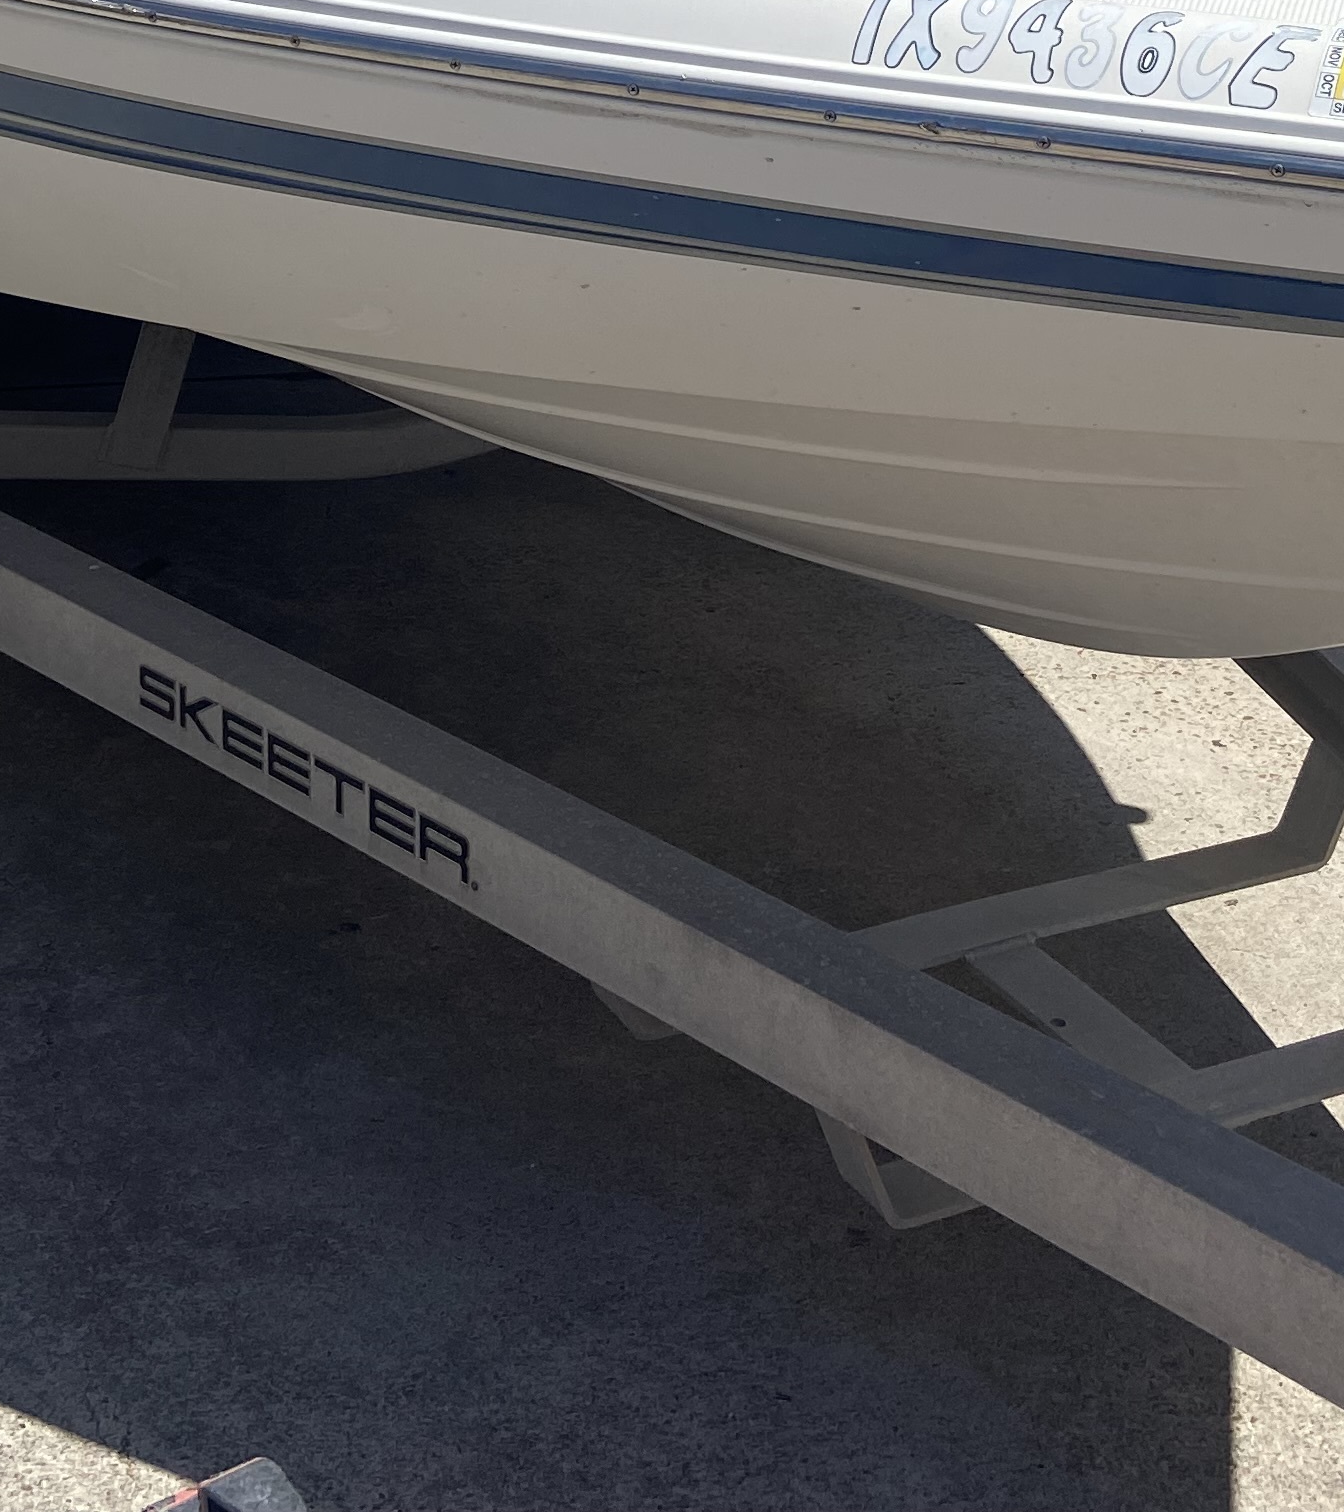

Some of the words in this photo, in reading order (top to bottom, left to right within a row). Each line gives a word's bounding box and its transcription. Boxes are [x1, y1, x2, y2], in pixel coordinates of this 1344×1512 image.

[1328, 46, 1343, 67] NOV
[1321, 74, 1335, 97] OCT
[139, 664, 470, 886] SKEETER
